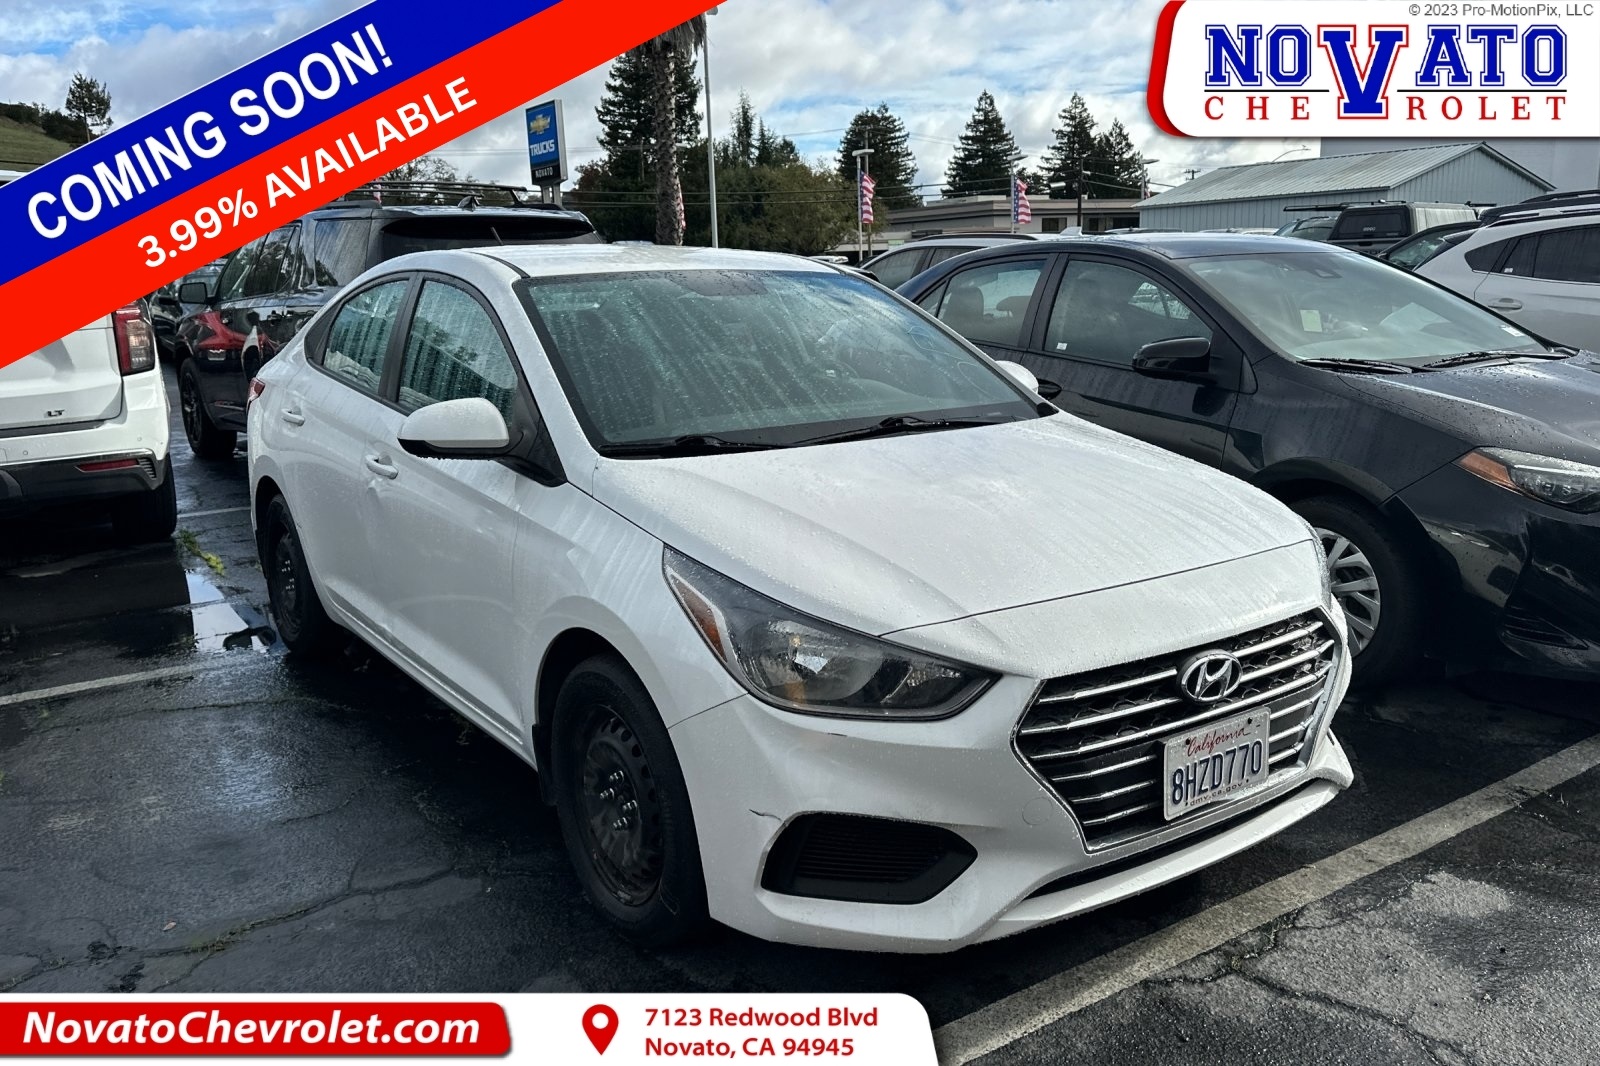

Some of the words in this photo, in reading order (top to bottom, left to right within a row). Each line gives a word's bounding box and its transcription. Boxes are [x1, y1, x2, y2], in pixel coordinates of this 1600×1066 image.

[530, 139, 555, 156] TRUCKS
[535, 167, 554, 178] NOVATO
[1188, 726, 1251, 755] California
[1172, 741, 1263, 805] 8HZD770
[1190, 781, 1243, 804] dmv.ca.gov
